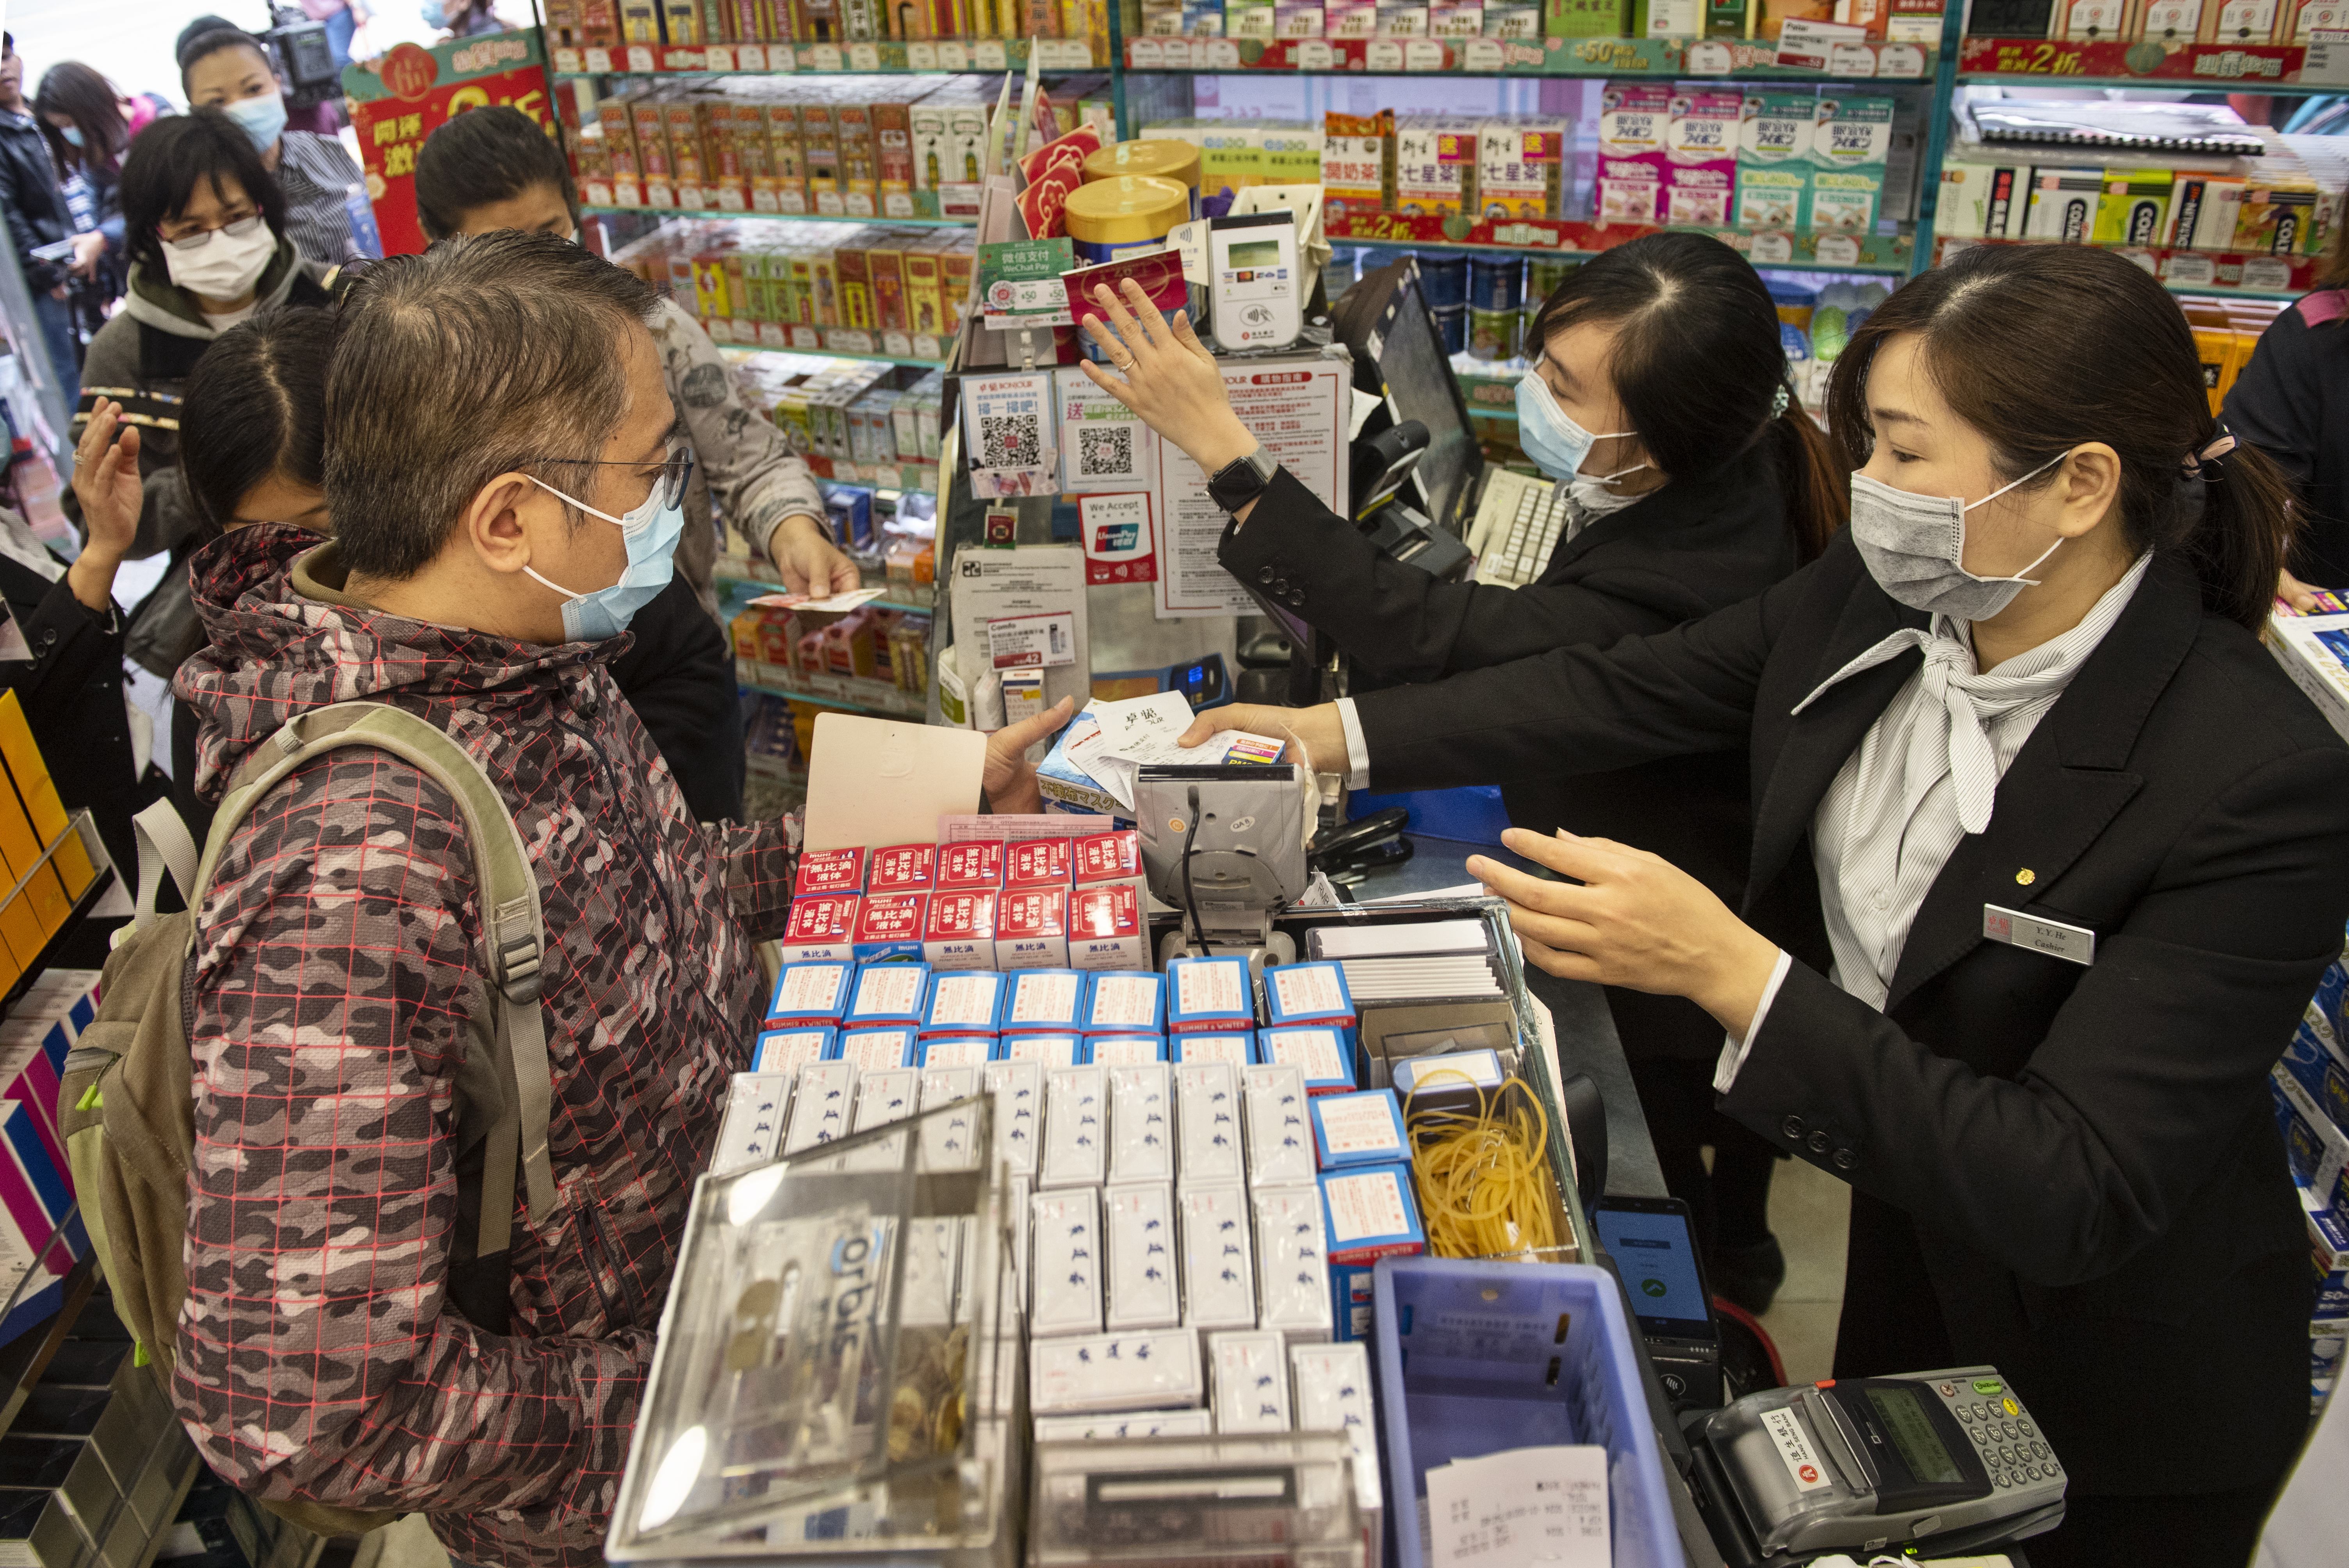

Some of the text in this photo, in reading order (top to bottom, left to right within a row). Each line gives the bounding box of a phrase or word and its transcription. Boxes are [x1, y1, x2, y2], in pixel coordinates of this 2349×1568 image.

[384, 139, 425, 178] 激
[1002, 249, 1049, 264] 微信支付
[1002, 264, 1034, 273] WeChat
[999, 380, 1033, 389] BONJOUR
[1067, 402, 1084, 420] 送
[1089, 501, 1138, 511] We Accept
[1097, 529, 1137, 540] UnionPay
[1025, 653, 1039, 663] 42
[810, 861, 852, 874] 無比滴
[869, 908, 913, 921] 無比滴
[2055, 931, 2067, 941] He
[2035, 939, 2065, 953] Cashier
[772, 1021, 800, 1029] SUMMER
[1178, 1024, 1208, 1033] SUMMER
[1217, 1021, 1246, 1030] WINTER
[1770, 1414, 1802, 1463] 恒生銀行
[1780, 1413, 1809, 1459] HANG SENG BANK
